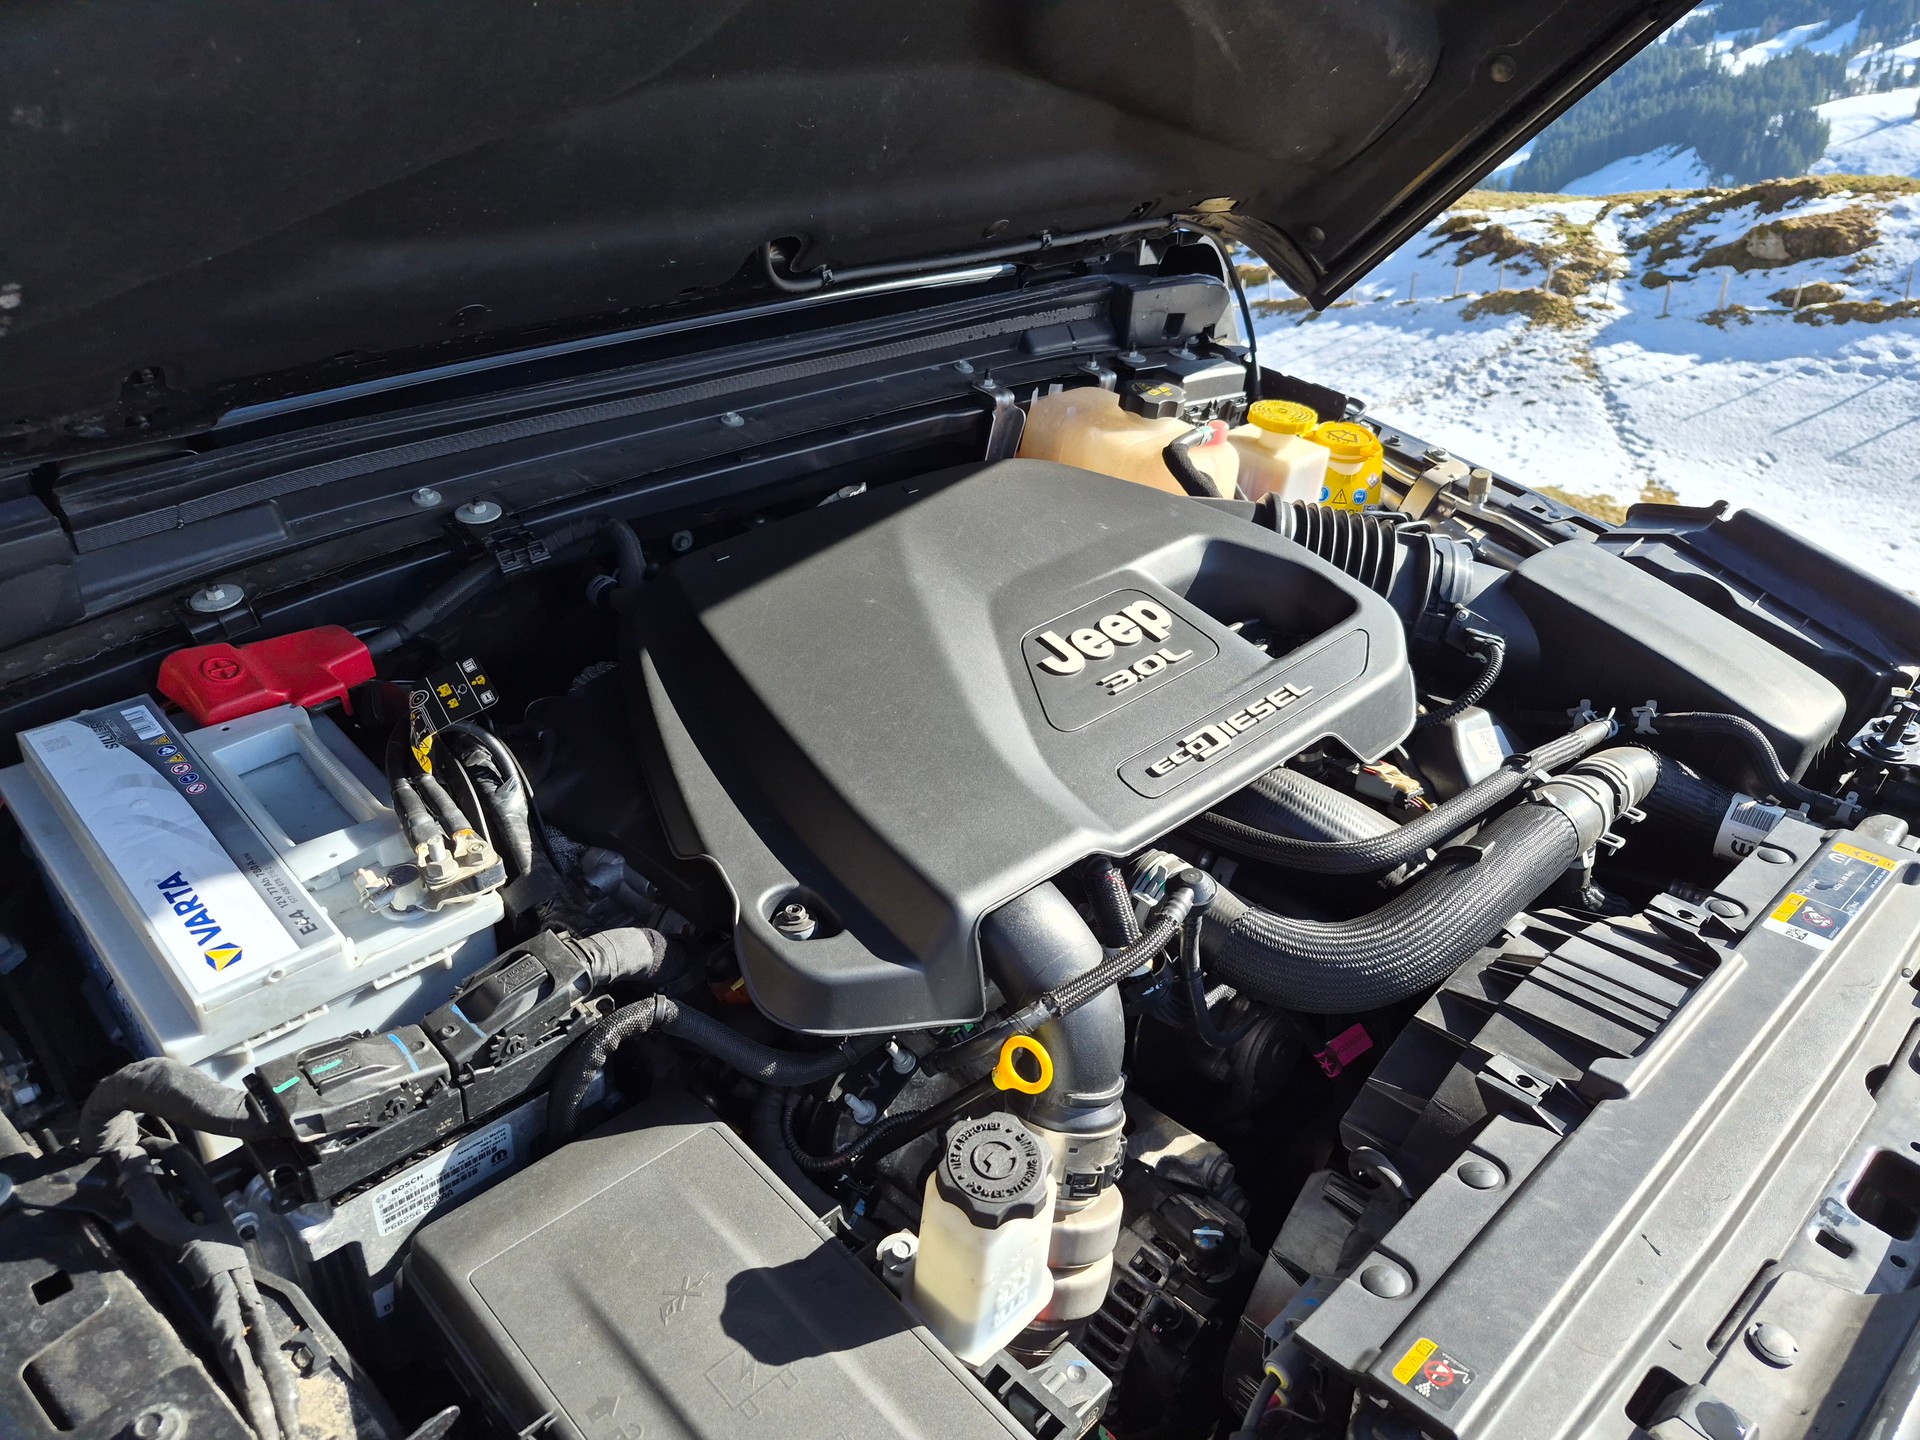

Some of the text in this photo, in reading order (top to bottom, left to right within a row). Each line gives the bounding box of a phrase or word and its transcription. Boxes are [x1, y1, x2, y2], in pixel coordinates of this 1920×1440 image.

[1040, 600, 1173, 675] Jeep
[1099, 648, 1194, 695] 3.0L
[90, 723, 120, 750] SILVER
[247, 860, 265, 878] 780A
[273, 896, 288, 909] 12V
[281, 886, 291, 895] 400
[287, 895, 298, 904] 577
[157, 870, 222, 947] VARTA
[953, 1122, 1002, 1152] APPROVED
[391, 1174, 424, 1195] BOSCH
[965, 1181, 1006, 1199] POWER
[1004, 1159, 1039, 1197] STEERING
[423, 1189, 454, 1212] 850AA
